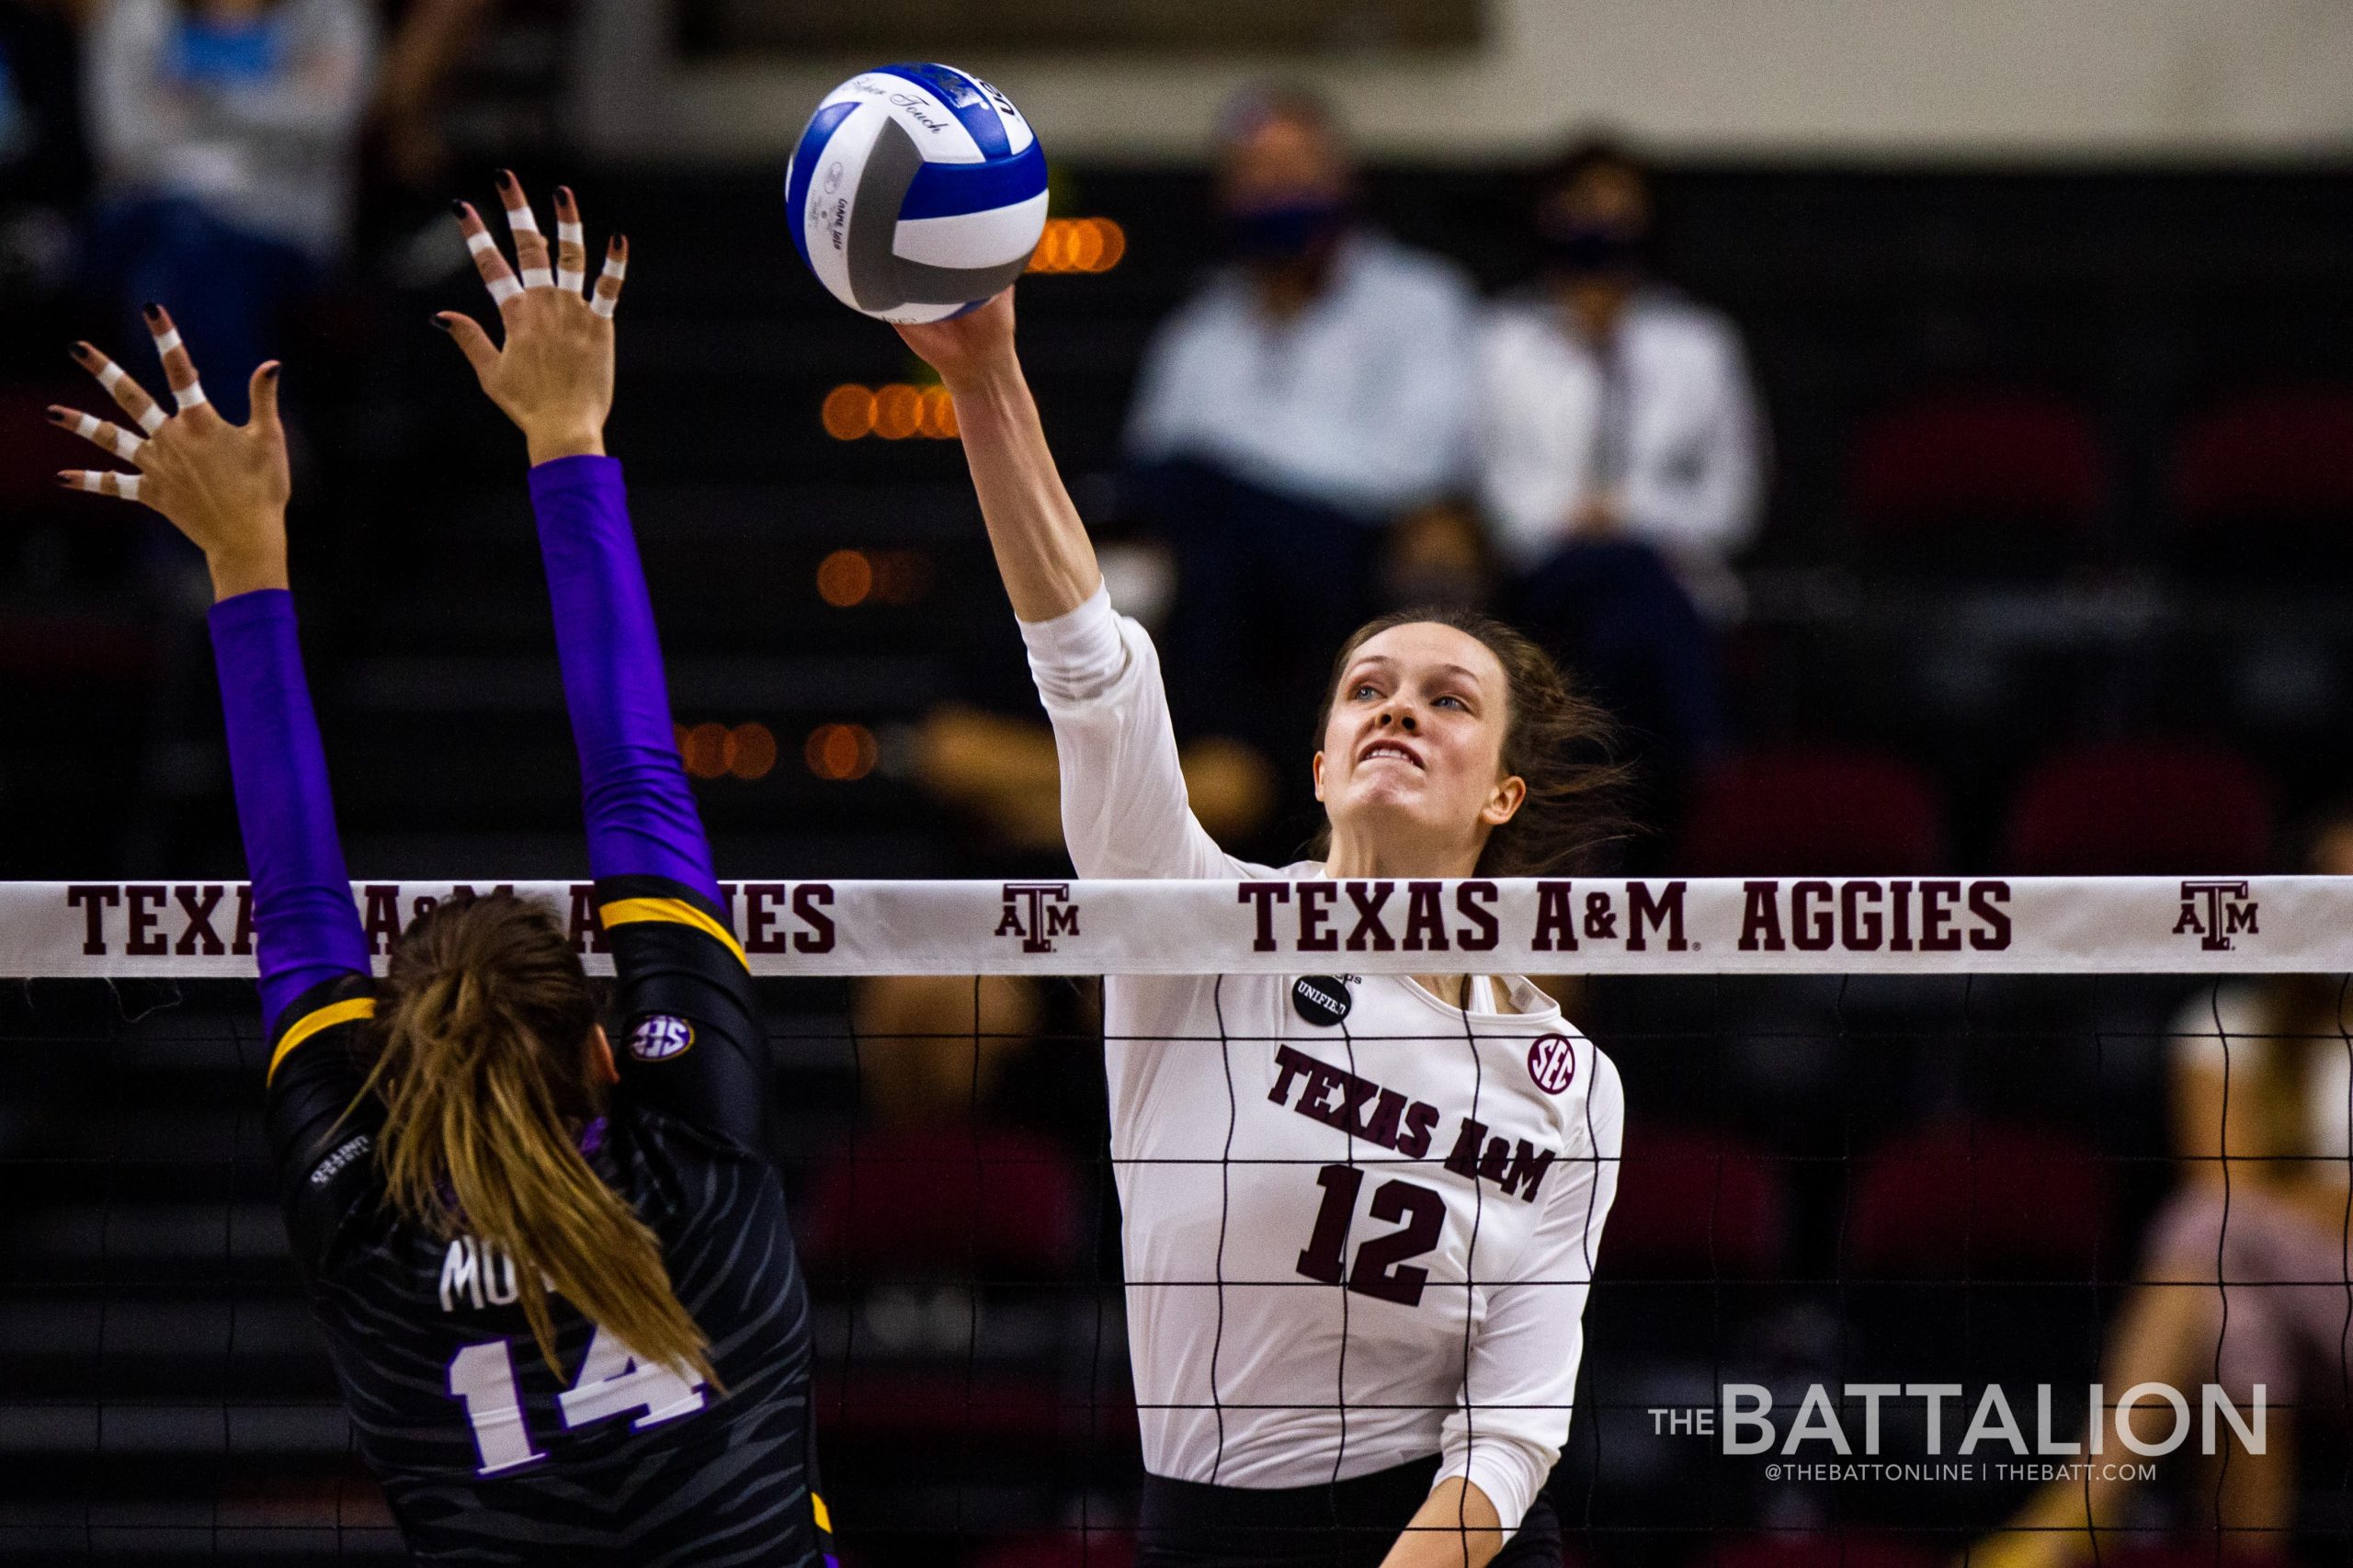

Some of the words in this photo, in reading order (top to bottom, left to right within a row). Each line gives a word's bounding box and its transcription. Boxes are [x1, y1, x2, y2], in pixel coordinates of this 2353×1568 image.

[889, 94, 949, 134] Touch
[67, 884, 257, 955] TEXA
[1238, 881, 1500, 952] TEXAS
[1737, 881, 2012, 951] AGGIES
[1297, 980, 1347, 1016] UNIFIED
[1531, 1037, 1574, 1091] SEC
[1267, 1043, 1440, 1160] TEXAS
[1444, 1117, 1556, 1204] A&M
[1295, 1164, 1447, 1307] 12
[443, 1324, 710, 1478] 14
